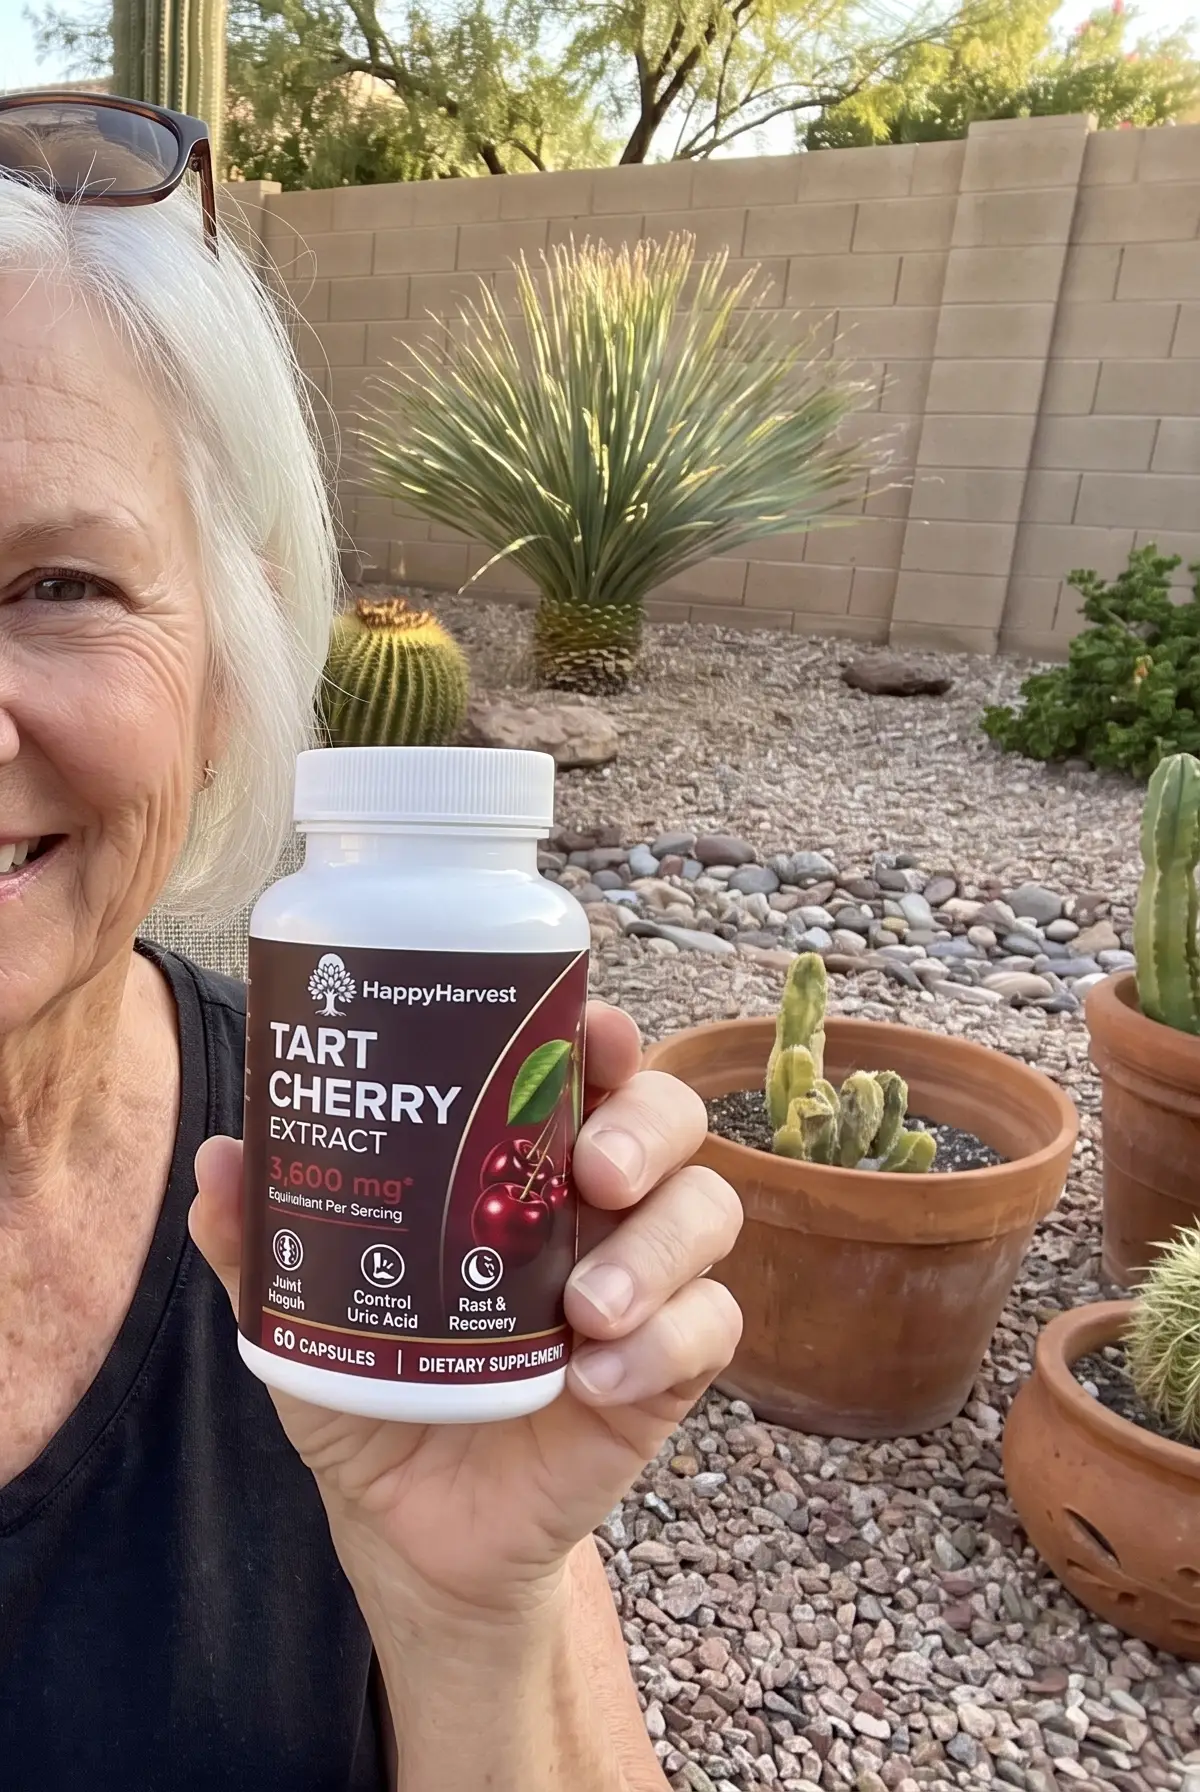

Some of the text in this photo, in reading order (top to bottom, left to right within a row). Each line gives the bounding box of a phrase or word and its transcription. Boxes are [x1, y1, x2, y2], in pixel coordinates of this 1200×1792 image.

[363, 981, 517, 1006] HappyHarvest
[270, 1021, 378, 1069] TART
[269, 1070, 462, 1124] CHERRY
[270, 1116, 387, 1154] EXTRACT
[270, 1156, 343, 1192] 3,600
[326, 1199, 347, 1214] Per
[350, 1203, 403, 1224] Sercing
[354, 1289, 411, 1310] Control
[459, 1296, 506, 1313] Rast &
[347, 1306, 418, 1329] Uric Acid
[449, 1315, 517, 1332] Recovery
[273, 1327, 375, 1367] 60 CAPSULES
[419, 1343, 564, 1373] DIETARY SUPPLEMENT
